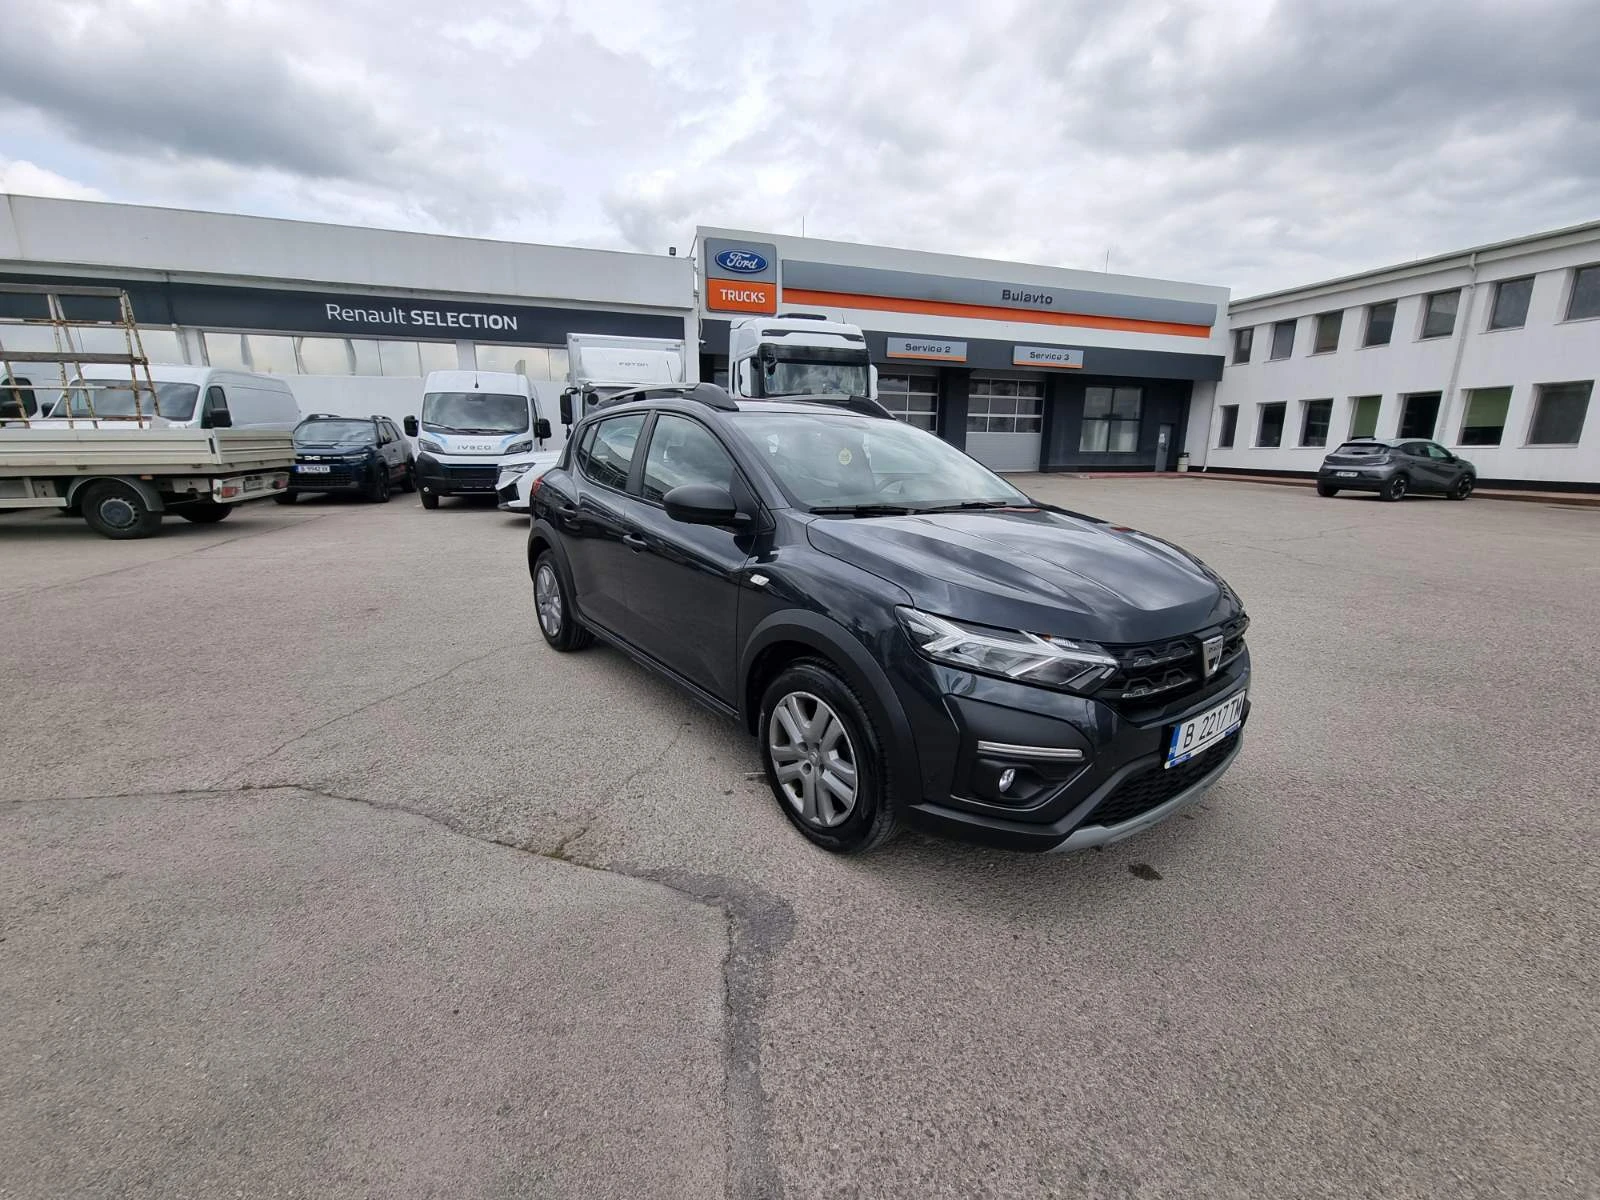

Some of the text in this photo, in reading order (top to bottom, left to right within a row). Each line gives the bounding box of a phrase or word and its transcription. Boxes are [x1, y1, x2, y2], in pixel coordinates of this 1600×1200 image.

[726, 252, 758, 269] Ford
[720, 288, 766, 304] TRUCKS
[1001, 289, 1053, 305] Bulavto
[325, 303, 518, 331] Renault SELECTION
[905, 343, 951, 353] Service 2
[1029, 351, 1070, 361] Service 3
[1183, 723, 1195, 749] B
[1199, 703, 1229, 742] 2217
